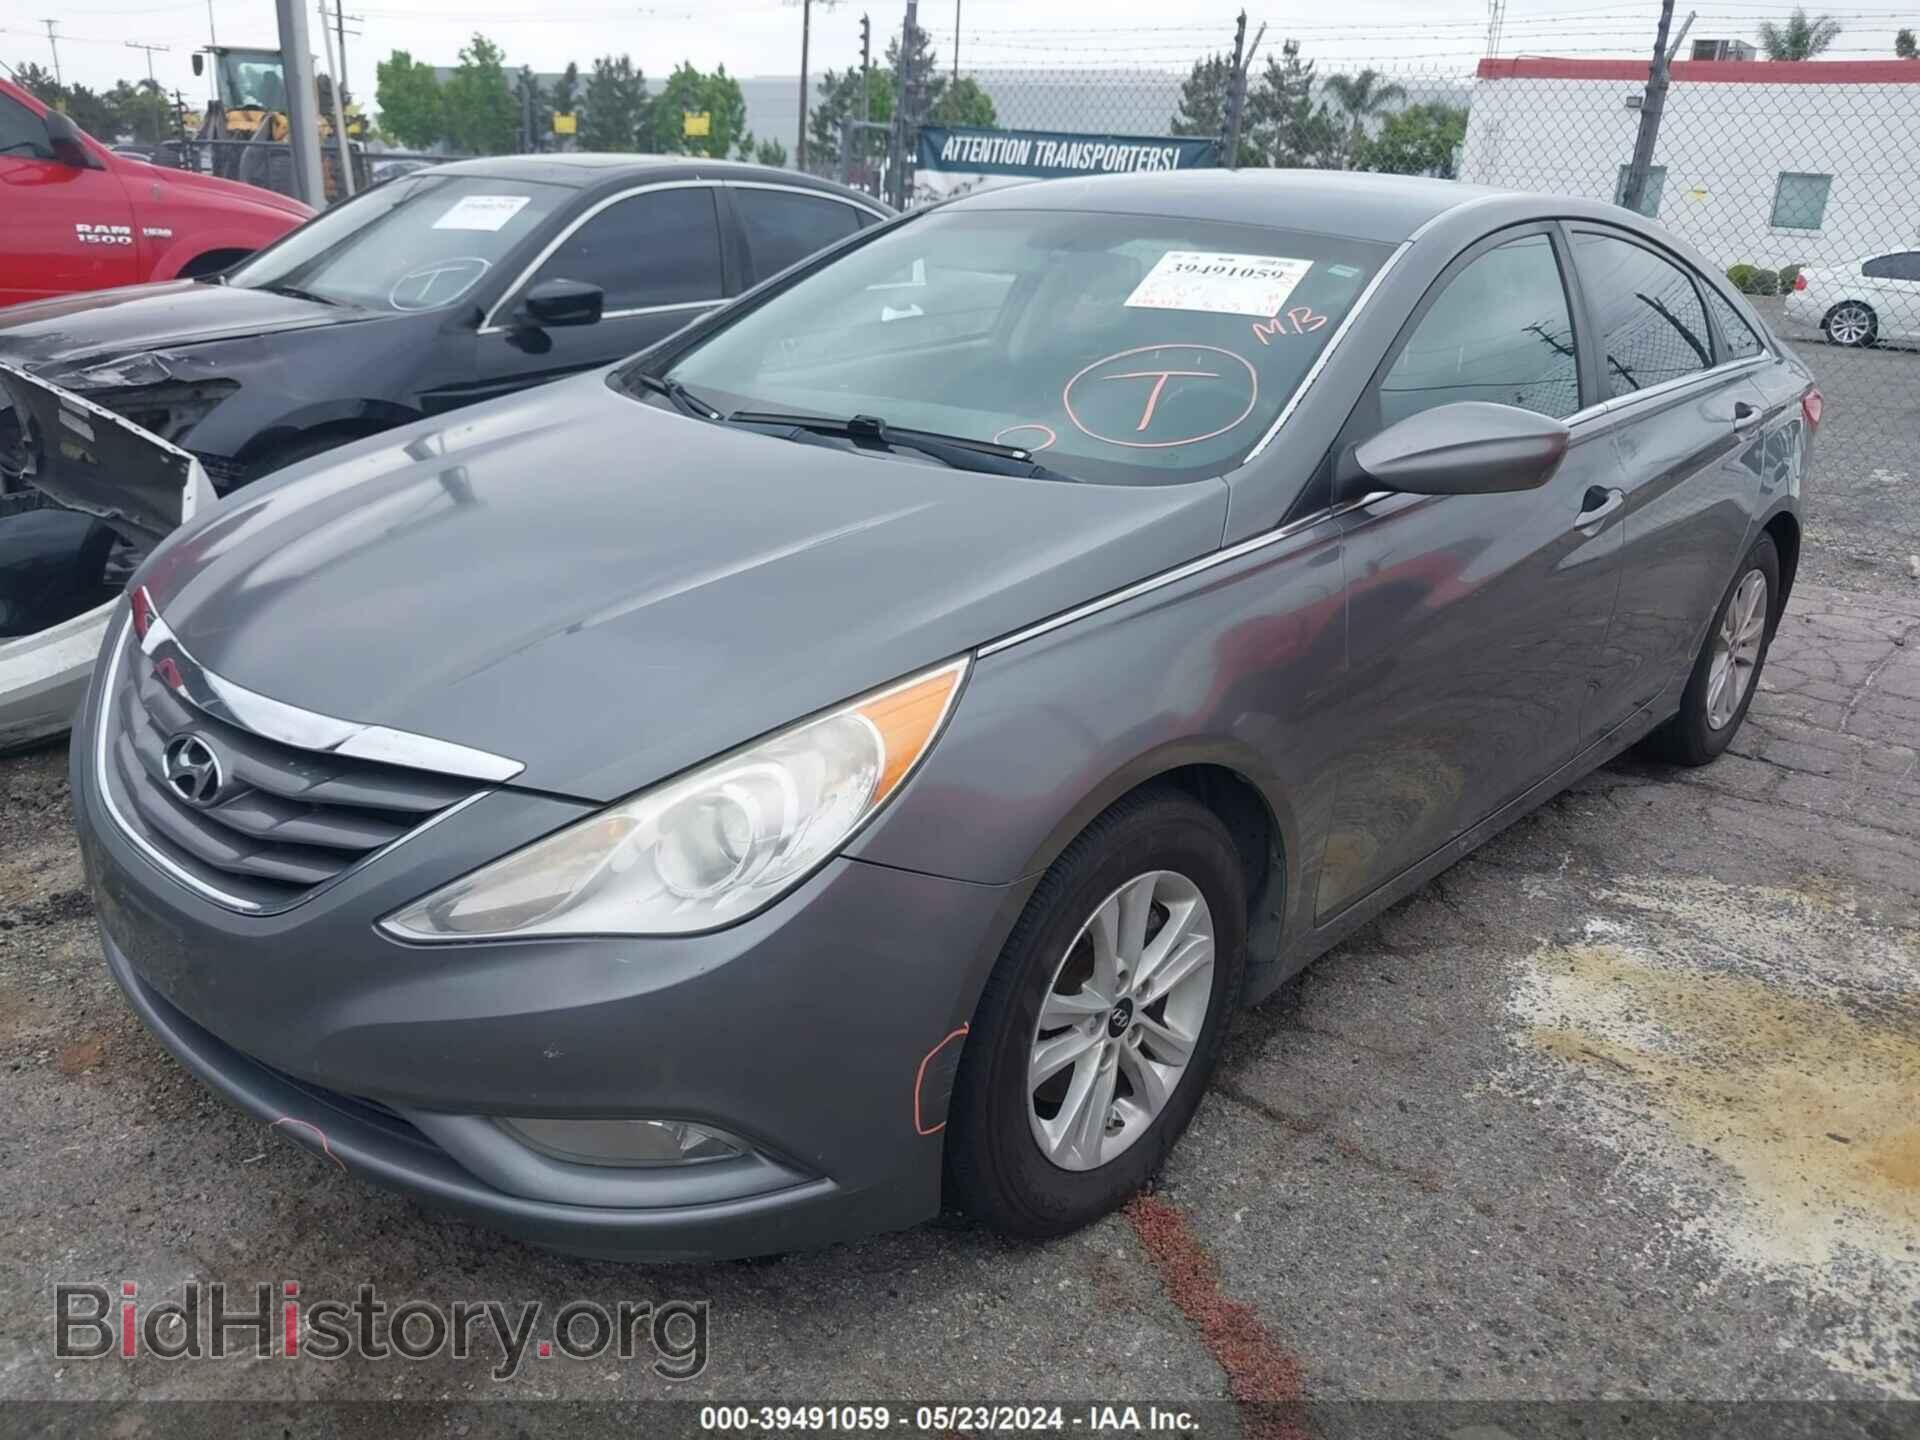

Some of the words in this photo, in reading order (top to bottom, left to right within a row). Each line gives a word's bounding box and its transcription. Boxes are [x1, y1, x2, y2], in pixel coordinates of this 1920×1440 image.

[941, 135, 1031, 166] ATTENTION
[1033, 140, 1181, 173] TRANSPORTERS!
[75, 224, 131, 235] RAM
[77, 234, 133, 245] 1500
[1168, 262, 1285, 280] 39491059
[1102, 371, 1221, 431] T
